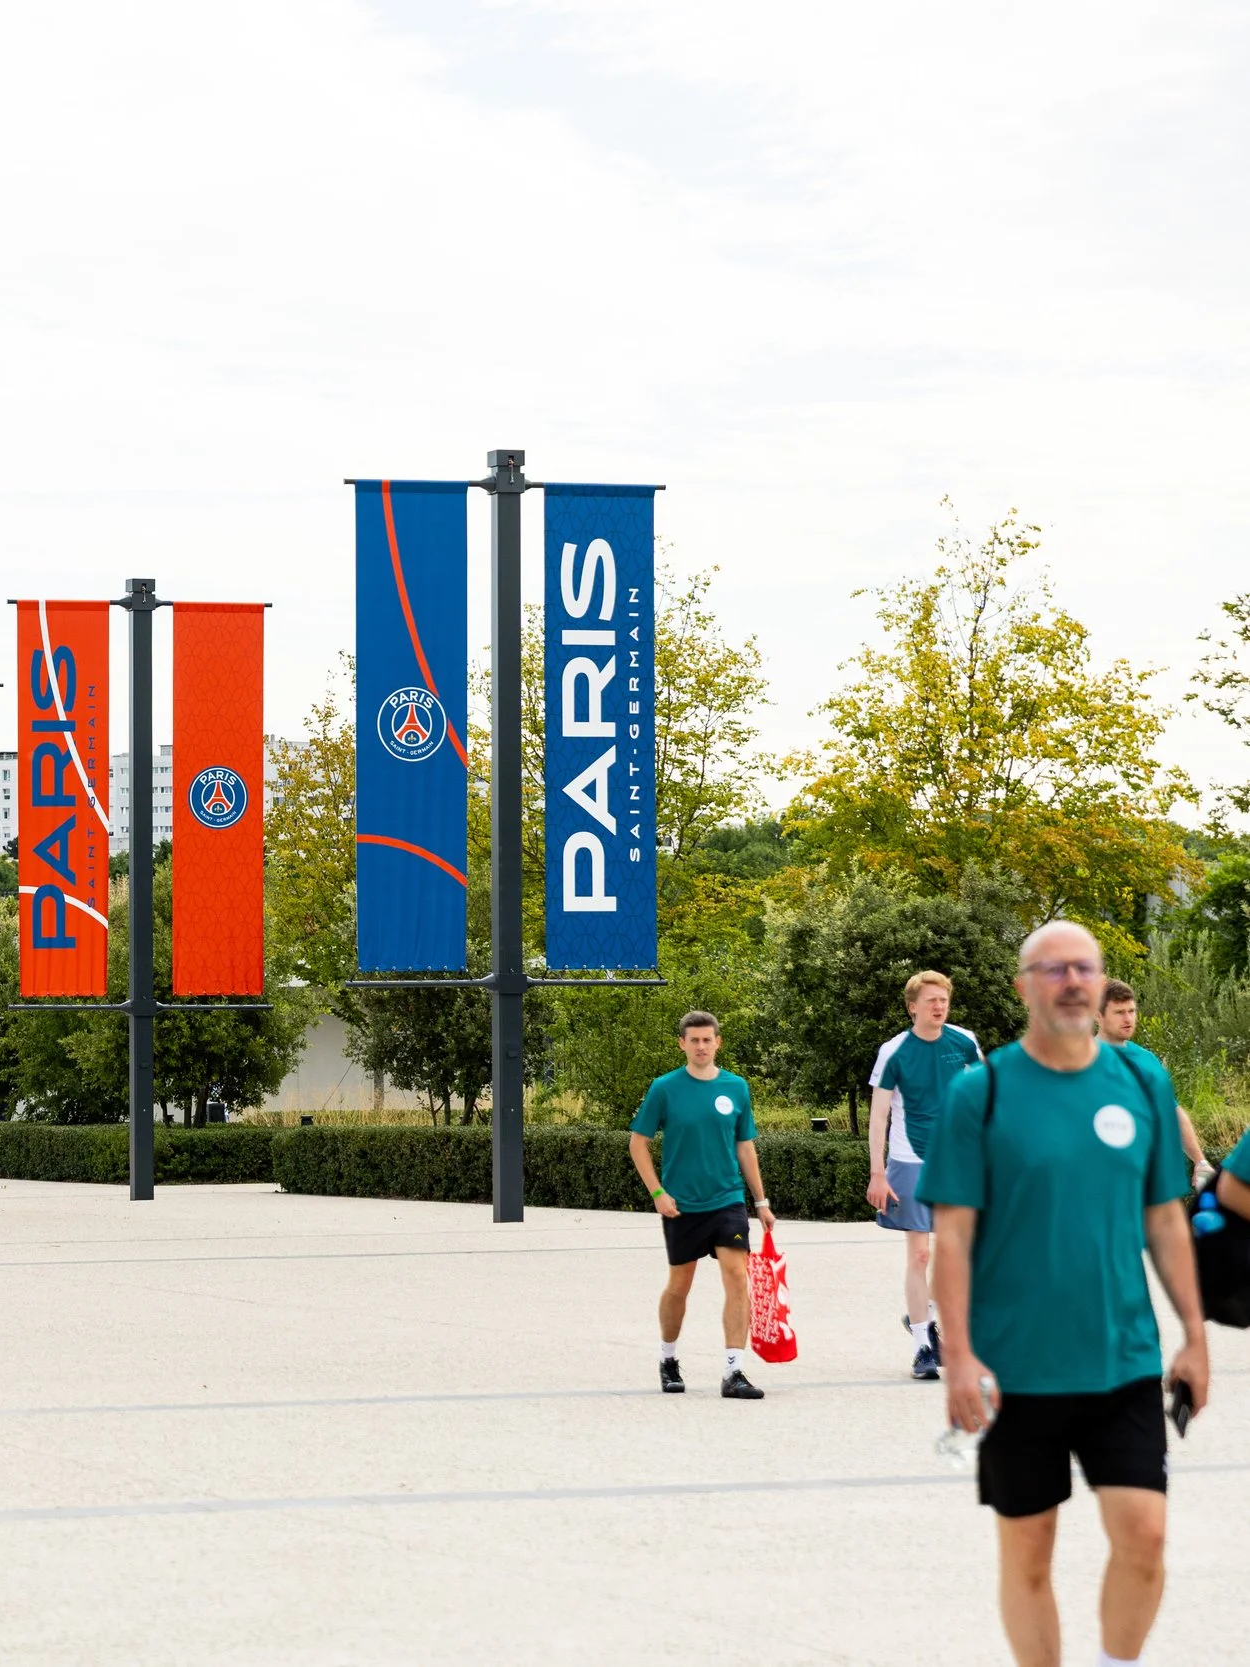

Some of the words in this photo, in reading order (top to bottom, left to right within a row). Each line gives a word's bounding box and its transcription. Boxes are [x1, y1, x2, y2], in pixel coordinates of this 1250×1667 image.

[30, 645, 76, 949] PARIS
[87, 685, 96, 908] SAINT-GERMAIN
[199, 770, 237, 785] PARIS
[389, 690, 434, 709] PARIS
[561, 538, 617, 912] PARIS
[629, 587, 640, 862] SAINT-GERMAIN
